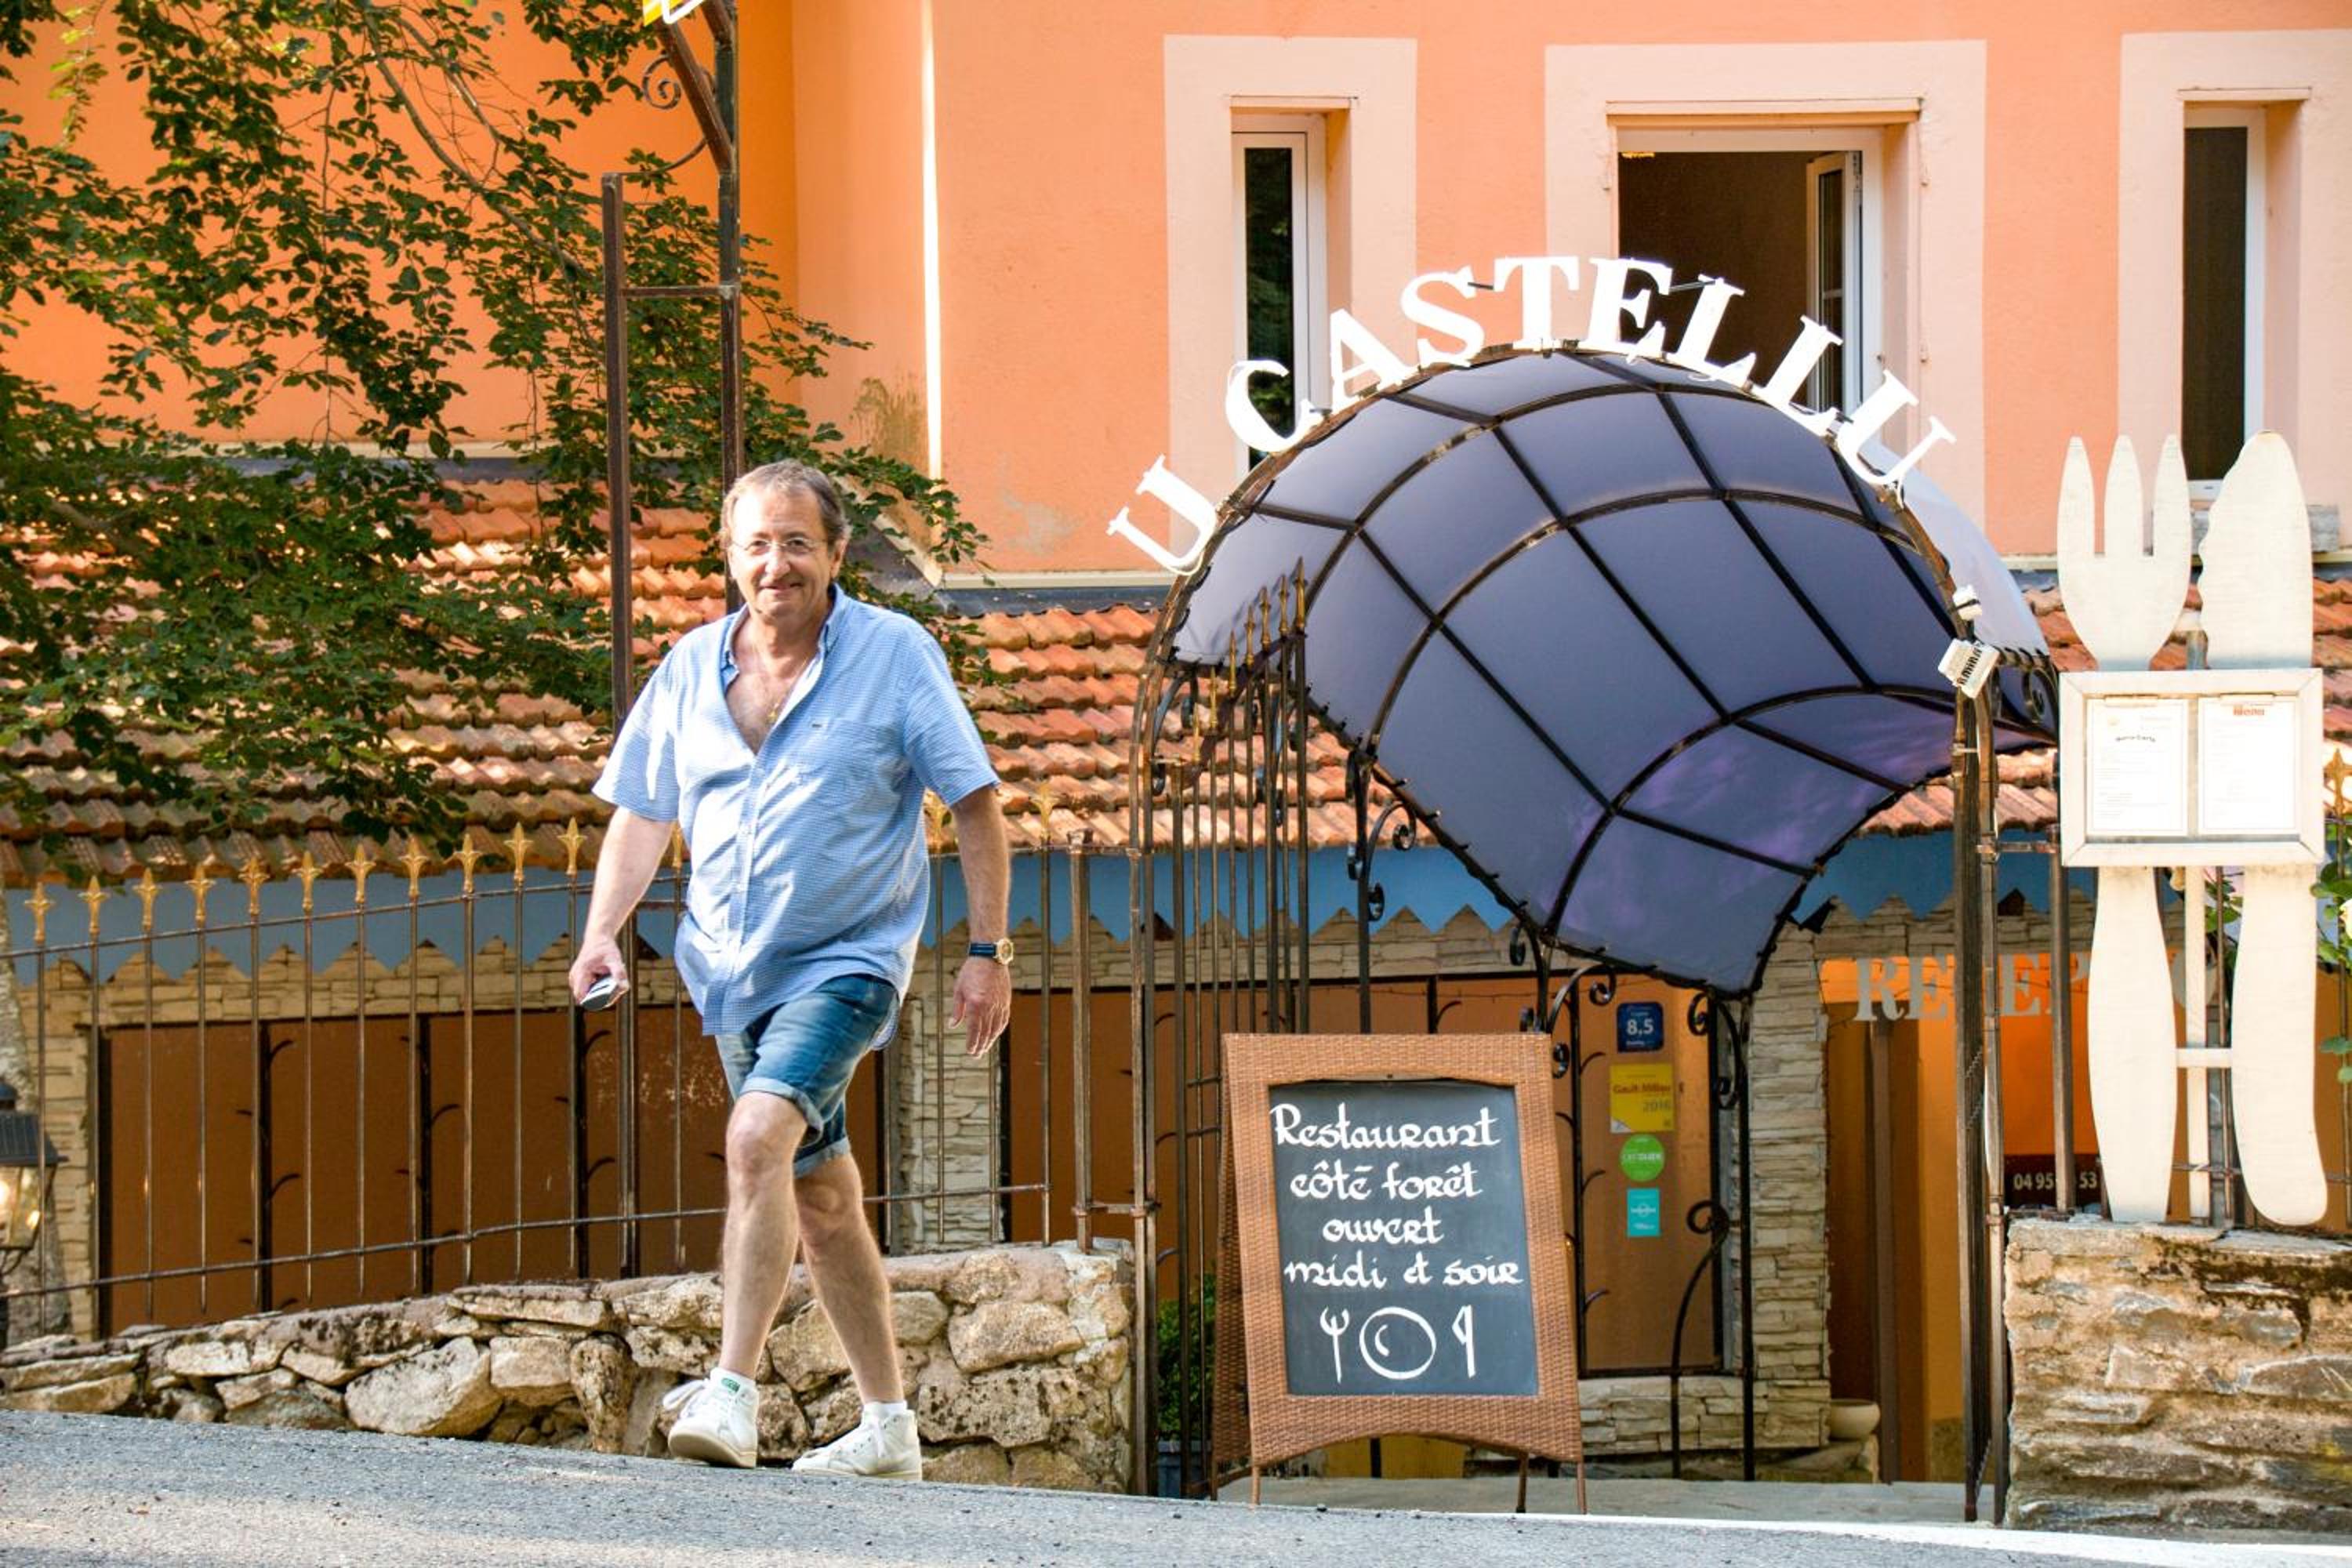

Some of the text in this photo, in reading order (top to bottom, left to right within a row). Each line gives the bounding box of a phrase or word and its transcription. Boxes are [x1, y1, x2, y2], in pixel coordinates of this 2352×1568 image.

[1105, 255, 1957, 576] U CASTELLU
[1625, 1018, 1655, 1037] 8,5
[1269, 1102, 1501, 1150] Restaurant
[1381, 1161, 1484, 1200] forêt
[2013, 1171, 2098, 1190] 04 95 53
[1322, 1205, 1445, 1245] ouvert
[1283, 1250, 1525, 1289] midi et soir
